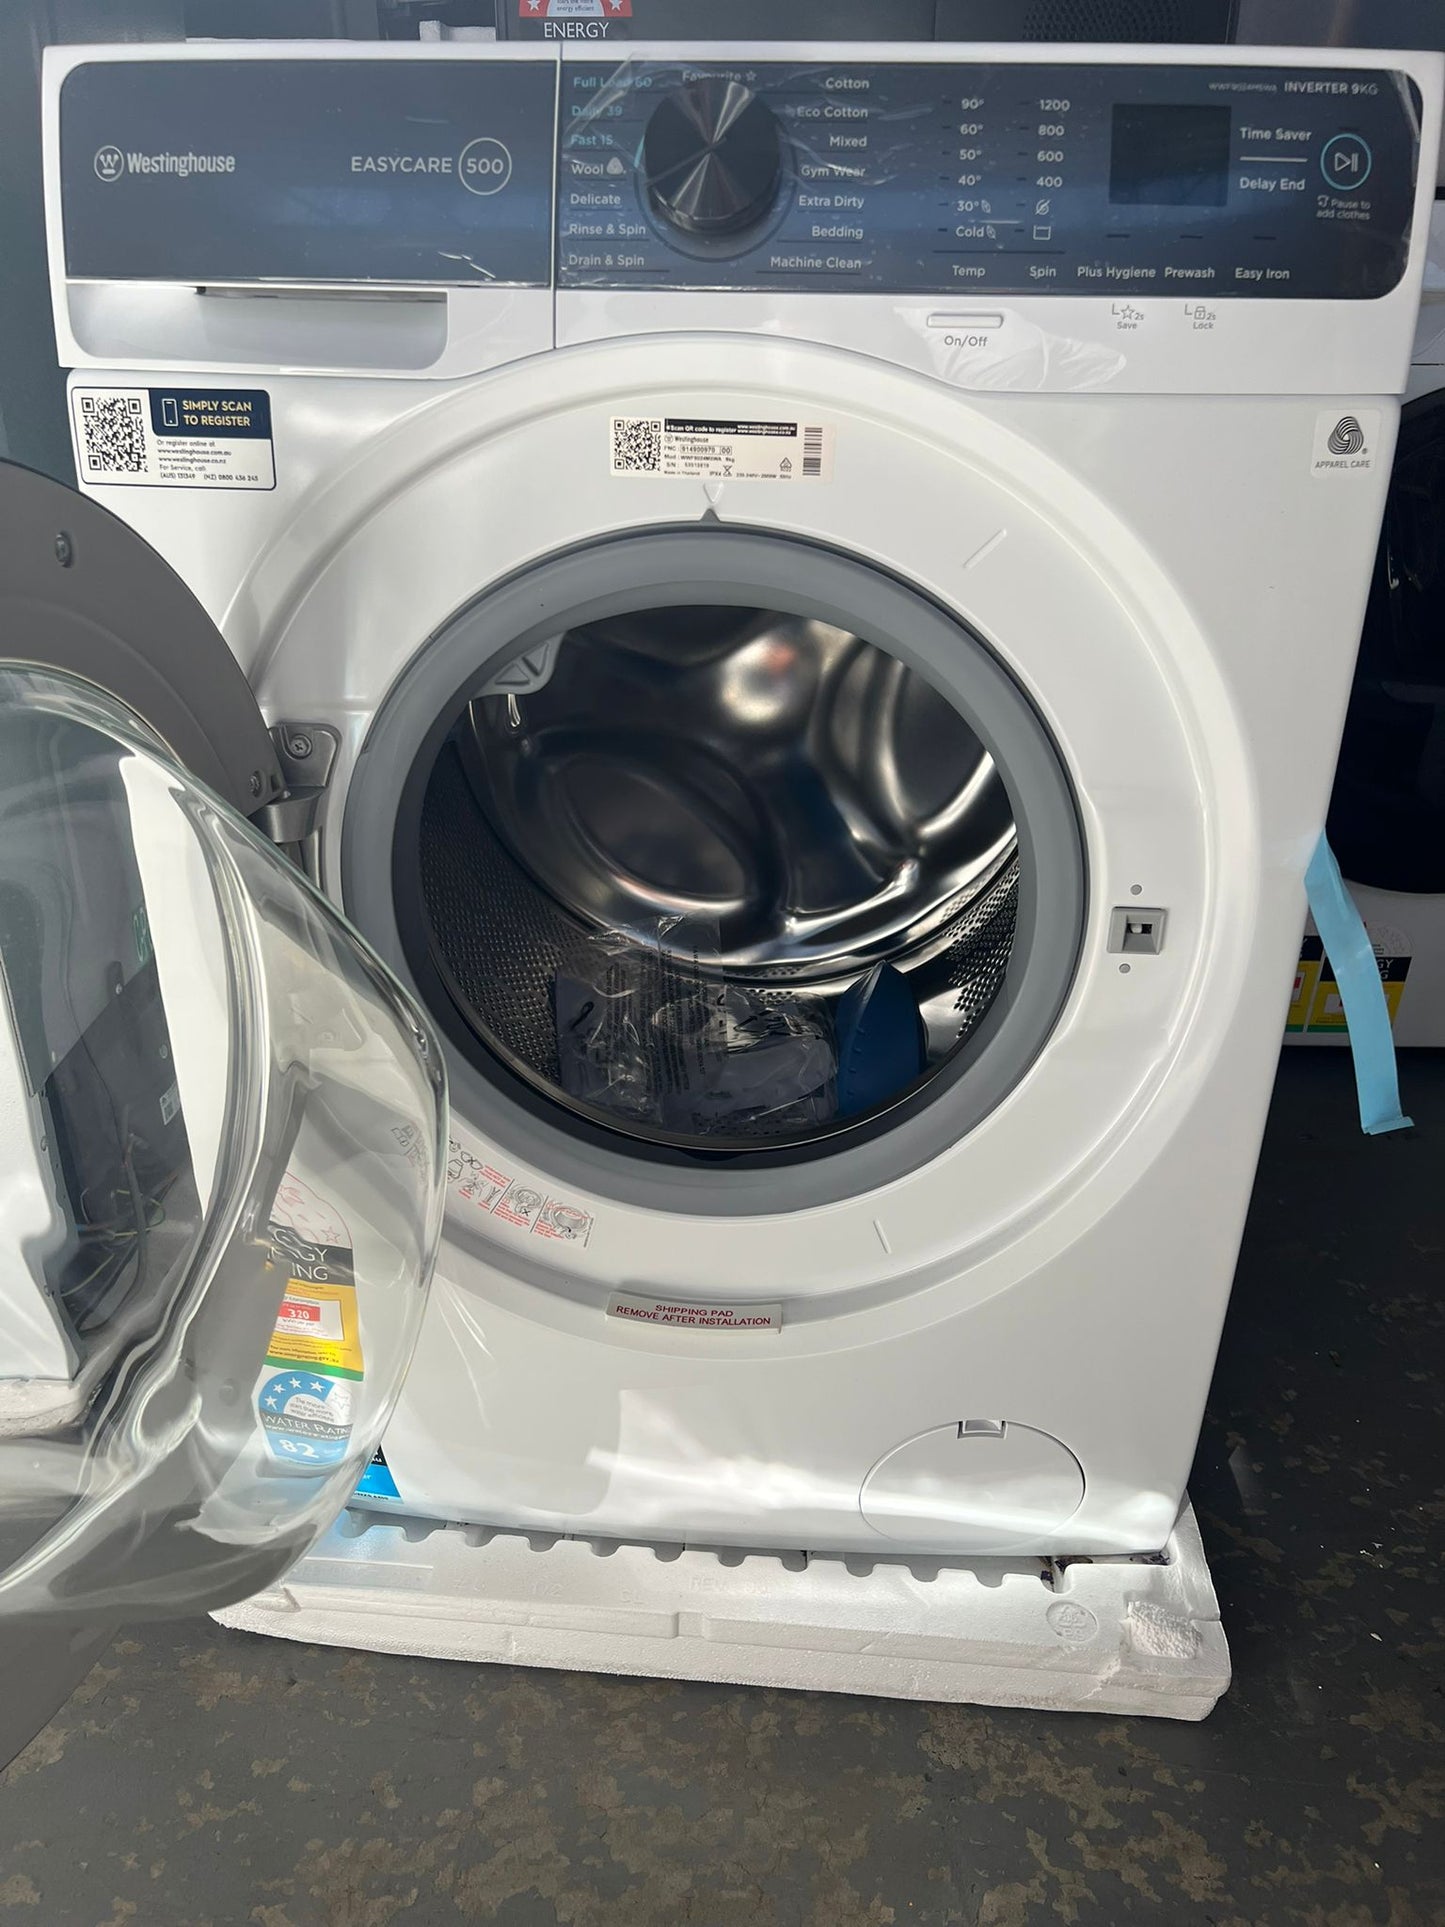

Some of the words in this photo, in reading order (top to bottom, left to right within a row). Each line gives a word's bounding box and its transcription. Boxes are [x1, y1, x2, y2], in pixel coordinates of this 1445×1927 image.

[543, 21, 609, 38] ENERGY
[573, 76, 597, 88] Full
[635, 76, 652, 88] 60
[825, 76, 870, 90] Cotton
[1284, 80, 1348, 95] INVERTER
[1351, 83, 1379, 96] 9KG
[606, 105, 623, 117] 39
[796, 105, 820, 118] Eco
[824, 106, 868, 118] Cotton
[1039, 98, 1071, 112] 1200
[1038, 124, 1065, 137] 800
[1239, 126, 1271, 140] Time
[1275, 127, 1313, 141] Saver
[570, 134, 597, 147] Fast
[600, 134, 614, 146] 15
[829, 135, 868, 148] Mixed
[1037, 150, 1064, 163] 600
[127, 151, 236, 178] Westinghouse
[350, 155, 453, 174] EASYCARE
[465, 157, 505, 176] 500
[571, 162, 604, 176] Wool
[801, 164, 830, 178] Gym
[833, 165, 866, 177] Wear
[1036, 175, 1063, 189] 400
[1239, 176, 1277, 192] Delay
[1280, 178, 1306, 191] End
[570, 192, 621, 206] Delicate
[798, 194, 831, 207] Extra
[834, 195, 865, 209] Dirty
[1360, 200, 1372, 210] to
[1316, 208, 1335, 219] add
[1336, 209, 1371, 221] clothes
[568, 224, 603, 236] Rinse
[605, 224, 615, 236] &
[618, 224, 646, 238] Spin
[811, 225, 864, 240] Bedding
[955, 225, 985, 238] Cold
[568, 254, 601, 267] Drain
[604, 255, 614, 267] &
[617, 255, 645, 269] Spin
[770, 255, 822, 269] Machine
[825, 256, 862, 270] Clean
[952, 264, 986, 278] Temp
[1029, 265, 1057, 279] Spin
[1077, 265, 1103, 278] Plus
[1105, 266, 1156, 281] Hygiene
[1164, 266, 1216, 279] Prewash
[1234, 267, 1263, 282] Easy
[1266, 268, 1290, 280] Iron
[1116, 320, 1137, 330] Save
[1193, 321, 1214, 330] Lock
[943, 333, 989, 348] On/Off
[182, 399, 219, 412] SIMPLY
[222, 400, 252, 412] SCAN
[183, 415, 199, 426] TO
[201, 415, 251, 427] REGISTER
[670, 424, 684, 432] Scan
[715, 427, 737, 435] register
[156, 439, 164, 447] Or
[166, 440, 188, 449] register
[189, 440, 207, 448] online
[158, 456, 227, 465] www.westinghouse.co.nz
[1314, 460, 1349, 469] APPAREL
[1350, 459, 1371, 469] CARE
[159, 464, 169, 472] For
[160, 472, 177, 480] (AUS)
[203, 473, 217, 482] (NZ)
[218, 474, 234, 482] 0800
[288, 1308, 310, 1320] 320
[616, 1304, 660, 1321] REMOVE
[661, 1313, 696, 1325] AFTER
[699, 1317, 771, 1326] INSTALLATION
[655, 1303, 708, 1317] SHIPPING
[710, 1309, 734, 1318] PAD
[279, 1438, 320, 1459] 82
